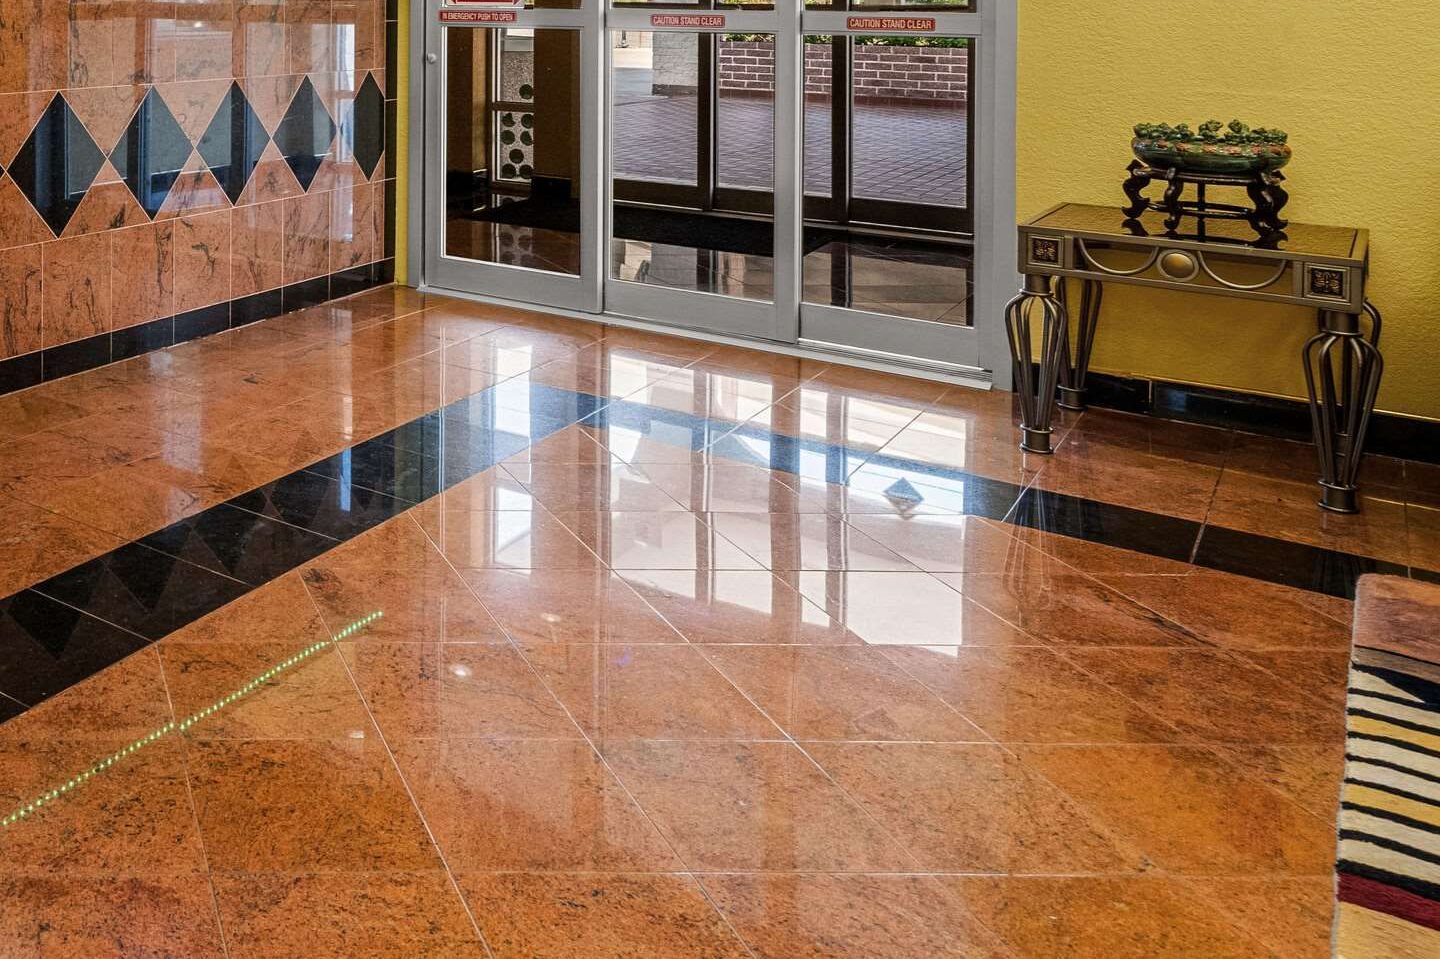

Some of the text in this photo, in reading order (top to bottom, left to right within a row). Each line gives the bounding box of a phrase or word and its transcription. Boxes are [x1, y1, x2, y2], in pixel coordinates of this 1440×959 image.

[442, 12, 513, 21] IN EMERGENCY PUSH TO OPEN
[653, 16, 722, 26] CAUTION STAND CLEAR
[849, 18, 932, 29] CAUTION STAND CLEAR
